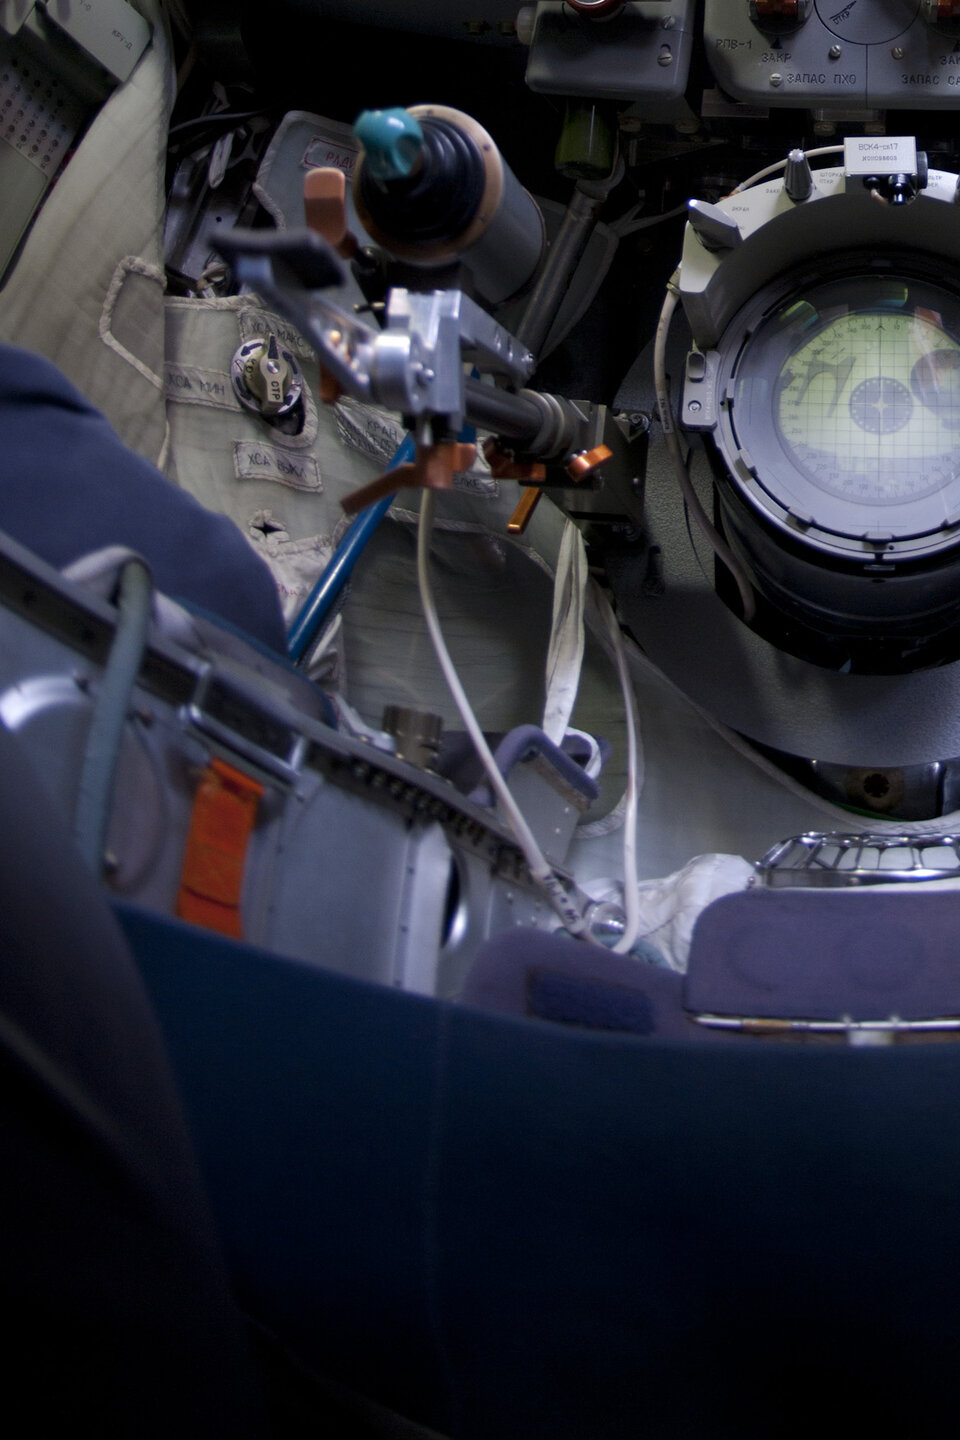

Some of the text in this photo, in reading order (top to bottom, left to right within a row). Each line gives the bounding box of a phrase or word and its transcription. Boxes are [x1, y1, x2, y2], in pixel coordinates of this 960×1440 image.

[715, 39, 752, 49] РПВ-1
[761, 53, 792, 63] ЗАКР
[787, 74, 857, 84] ЗАПАС ПХО
[901, 74, 940, 85] ЗАПАС
[271, 380, 281, 400] СТР
[247, 452, 271, 465] ХСА
